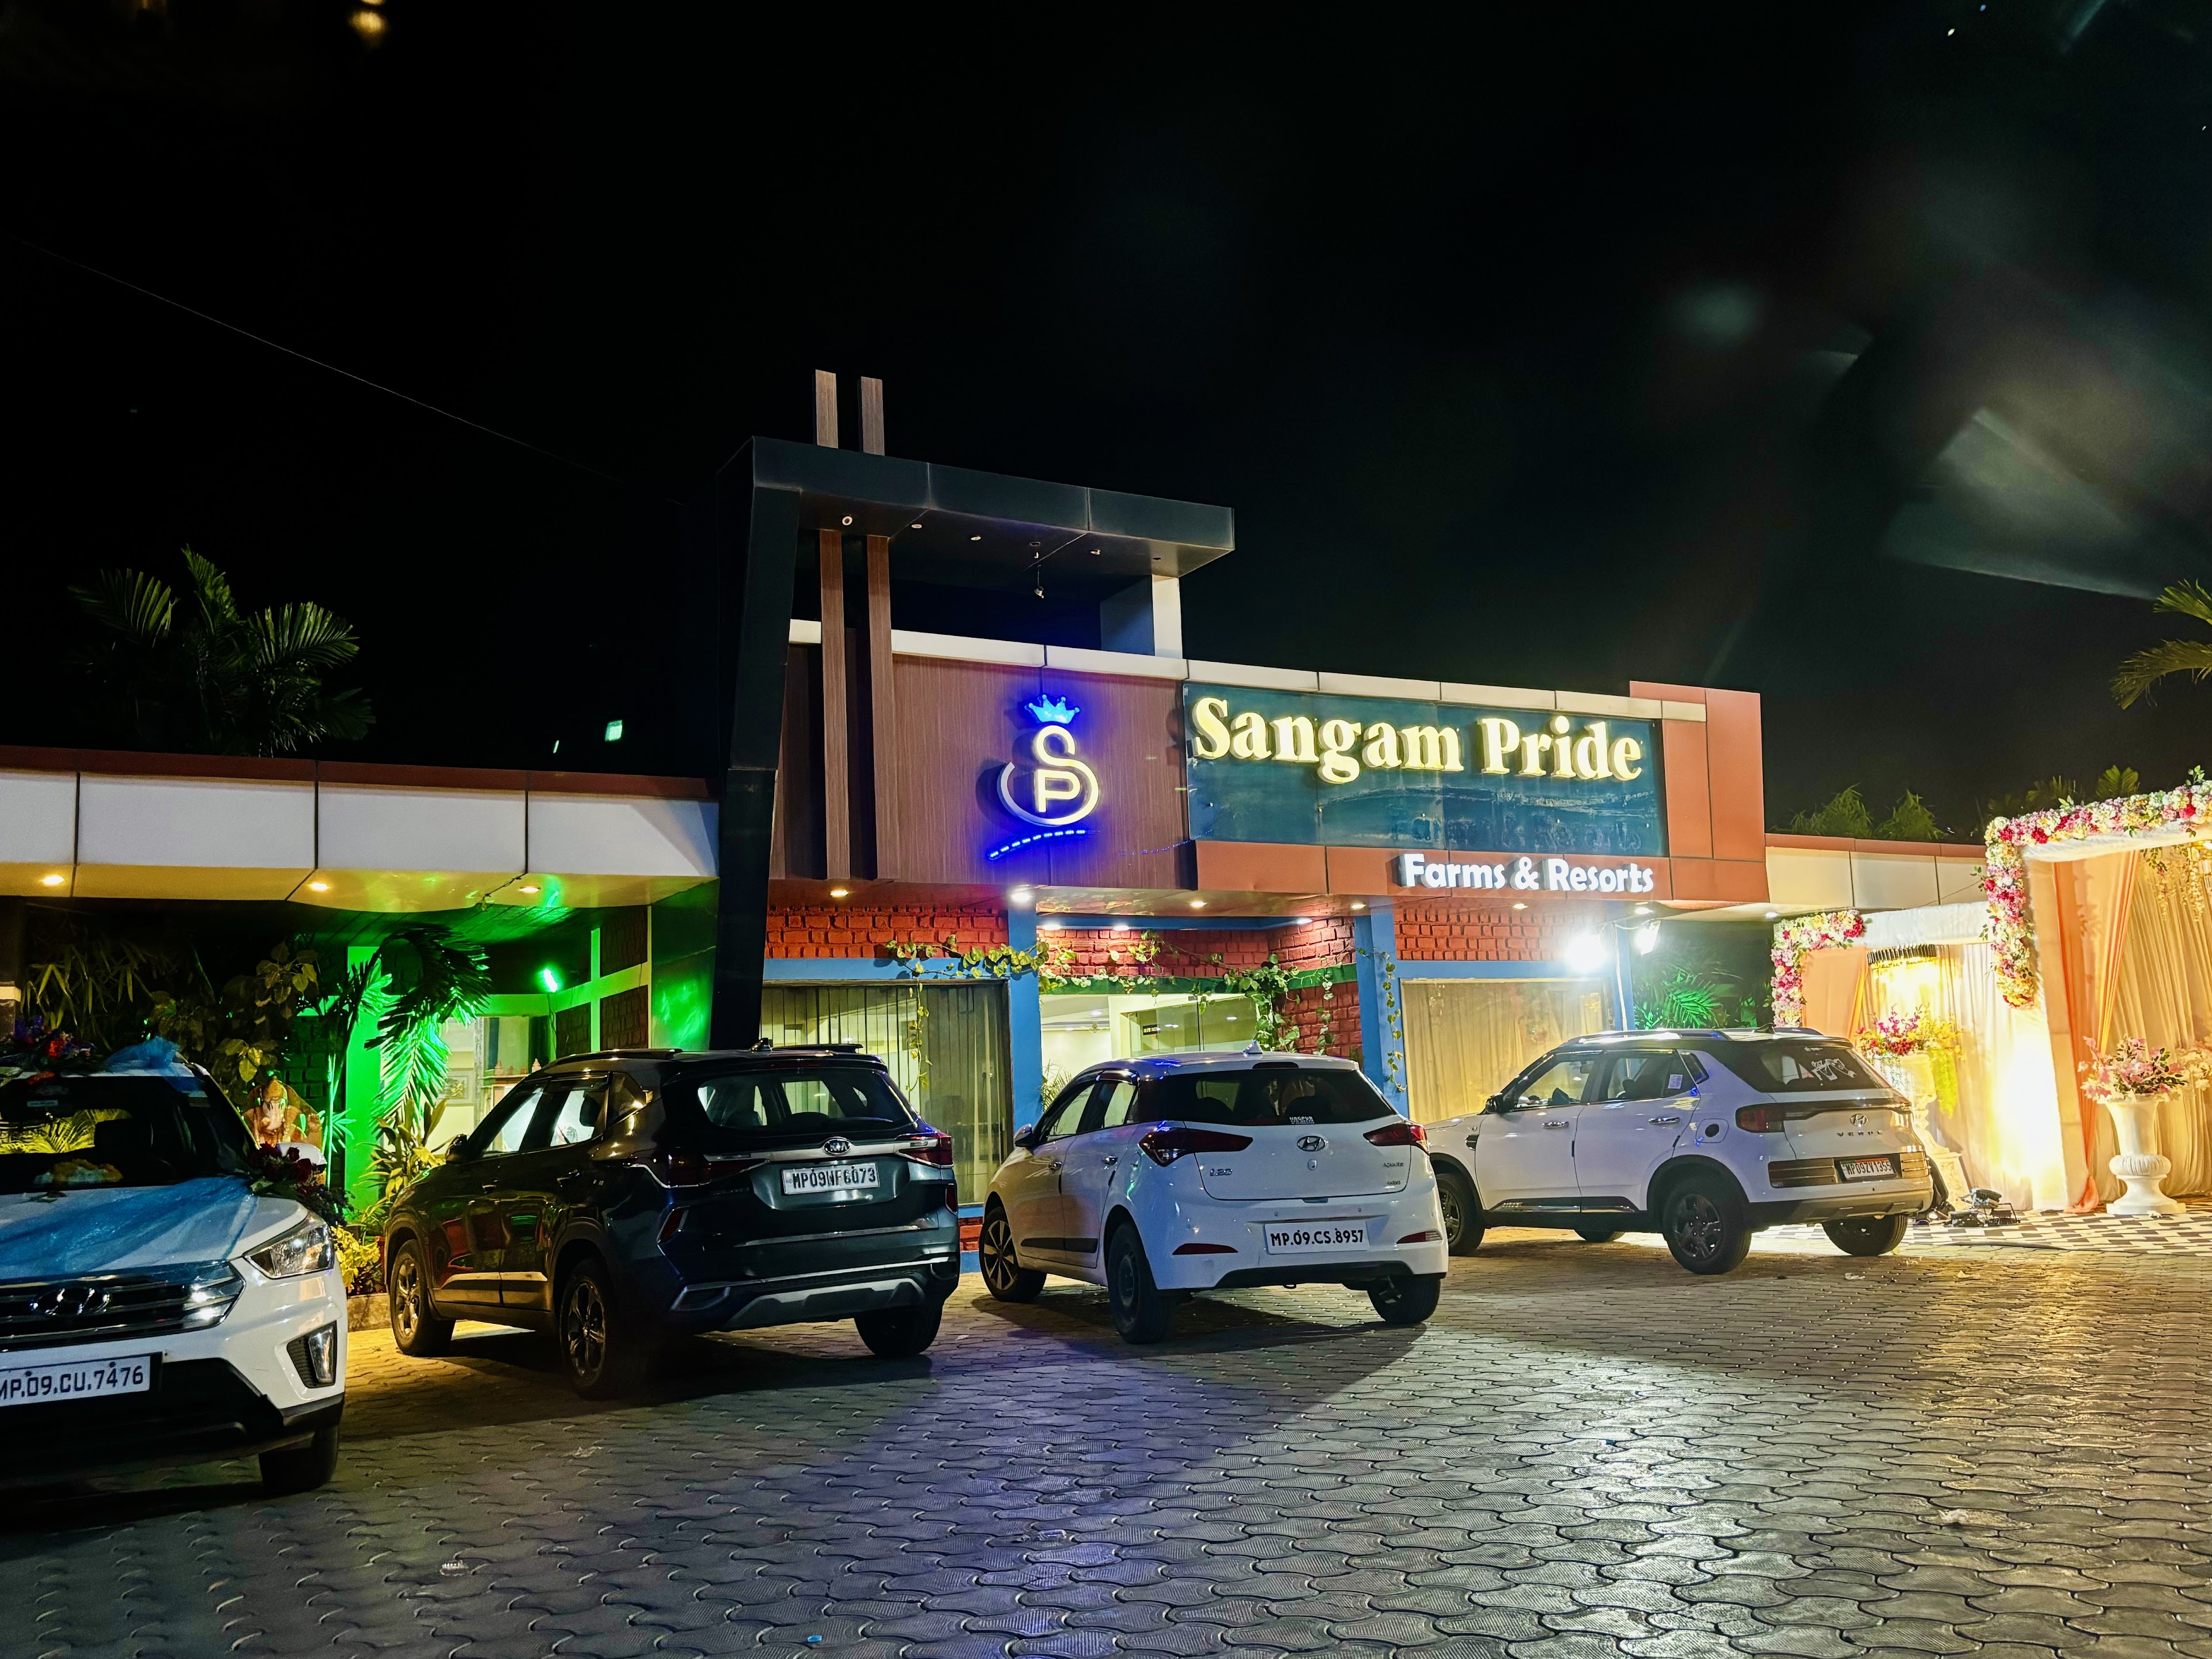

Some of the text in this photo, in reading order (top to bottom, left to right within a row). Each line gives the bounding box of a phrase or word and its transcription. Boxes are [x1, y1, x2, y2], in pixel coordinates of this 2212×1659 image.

[1192, 697, 1642, 784] Sangam Pride
[1401, 853, 1654, 893] Farms & Resorts
[1270, 1230, 1363, 1247] MP.09.CS.8957
